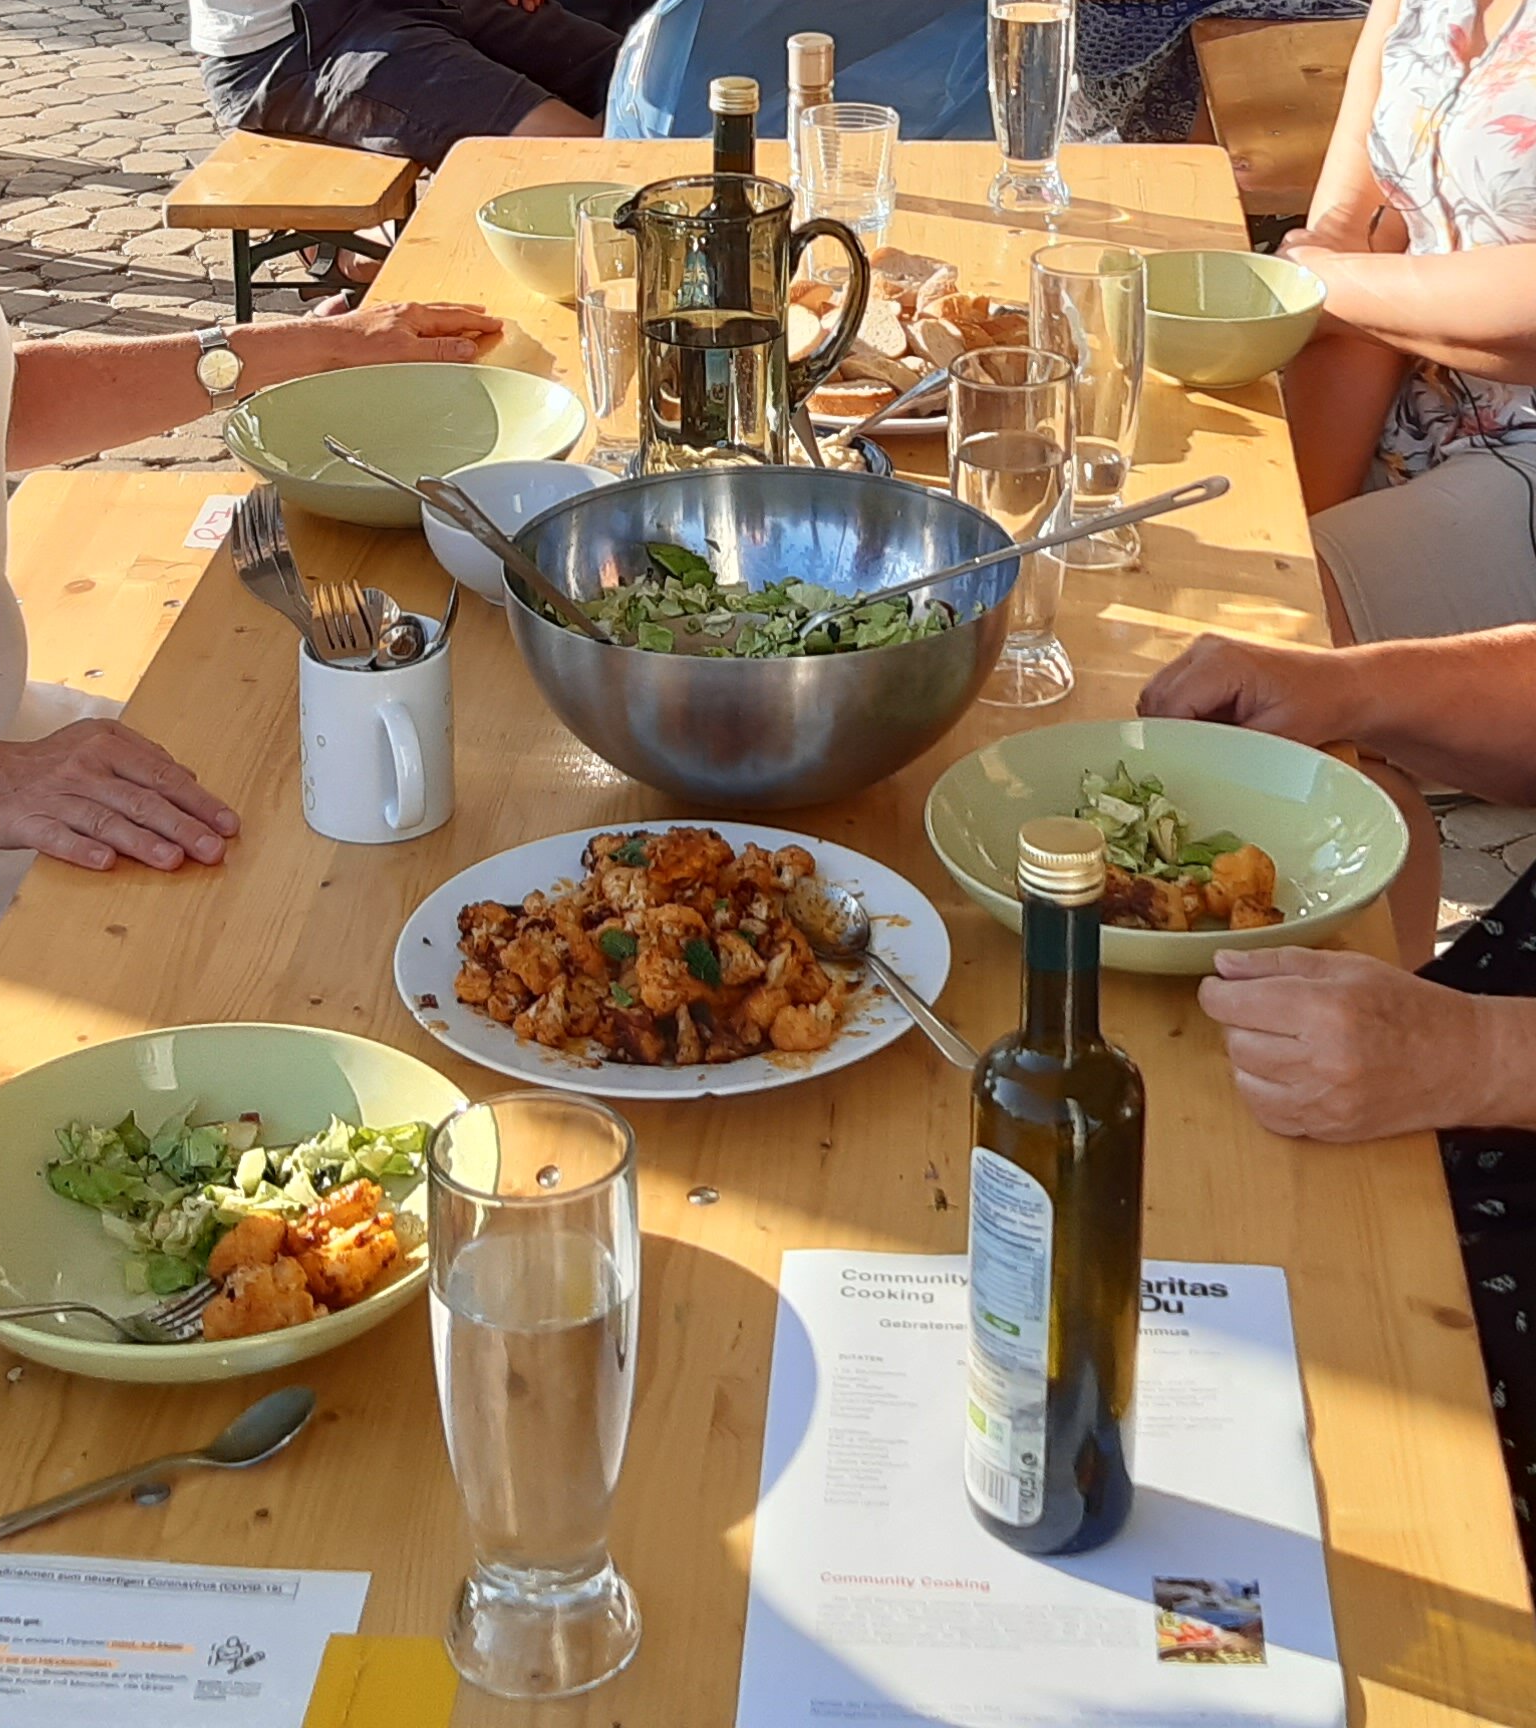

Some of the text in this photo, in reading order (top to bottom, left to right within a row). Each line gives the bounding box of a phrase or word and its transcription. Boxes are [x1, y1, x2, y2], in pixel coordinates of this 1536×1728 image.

[841, 1268, 1229, 1298] Community aritas
[840, 1285, 935, 1304] Cooking
[820, 1571, 992, 1593] Community Cooking
